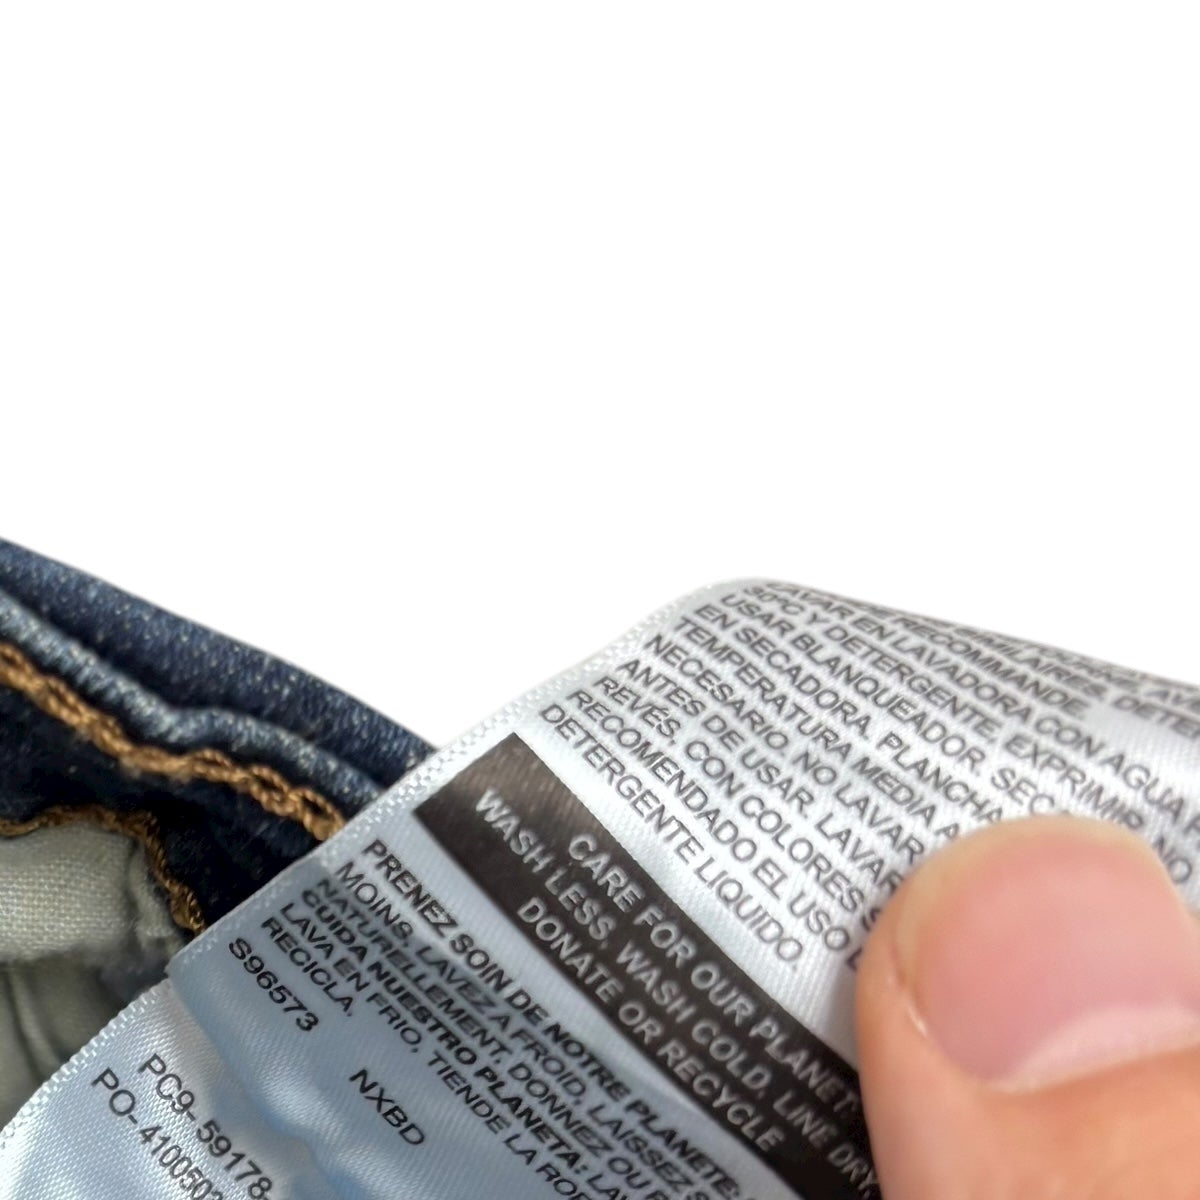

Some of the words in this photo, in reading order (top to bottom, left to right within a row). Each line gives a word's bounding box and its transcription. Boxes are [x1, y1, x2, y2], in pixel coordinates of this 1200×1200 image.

[616, 657, 707, 720] ANTES
[702, 713, 745, 752] DE
[741, 746, 816, 819] USAR.
[644, 634, 789, 756] NECESARIO.
[792, 750, 838, 787] NO
[835, 782, 925, 865] LAVAR
[674, 616, 853, 763] TEMPERATURA
[851, 756, 936, 827] MEDIA
[695, 604, 739, 630] EN
[734, 627, 872, 740] SECADORA.
[720, 594, 796, 637] USAR
[791, 633, 986, 776] BLANQUEADOR.
[991, 767, 1068, 815] SEC
[851, 616, 896, 640] EN
[891, 636, 1032, 724] LAVADORA
[1034, 716, 1105, 757] CON
[539, 704, 705, 865] DETERGENTE
[567, 688, 757, 863] RECOMENDADO
[751, 856, 789, 901] EL
[787, 891, 850, 951] USO
[685, 738, 745, 797] CON
[739, 795, 865, 913] COLORES
[279, 902, 335, 959] LAVA
[332, 959, 370, 993] EN
[365, 993, 423, 1053] FRIO,
[426, 1049, 512, 1135] TIENDE
[503, 1133, 538, 1165] LA
[302, 889, 368, 961] CUIDA
[367, 961, 478, 1066] NUESTRO
[474, 1066, 588, 1175] PLANETA:
[335, 860, 414, 948] MOINS,
[415, 945, 497, 1014] LAVEZ
[485, 1011, 511, 1032] A
[509, 1026, 587, 1105] FROID,
[587, 1103, 694, 1193] LAISSEZ
[362, 839, 460, 938] PRENEZ
[450, 933, 513, 994] SOIN
[507, 989, 550, 1027] DE
[543, 1022, 632, 1102] NOTRE
[474, 790, 548, 873] WASH
[615, 940, 697, 1024] WASH
[773, 1090, 838, 1147] LINE
[516, 897, 625, 1003] DONATE
[618, 1002, 664, 1045] OR
[657, 1040, 786, 1151] RECYCLE
[567, 833, 646, 913] CARE
[633, 905, 696, 968] FOR
[690, 962, 755, 1027] OUR
[228, 937, 319, 1032] S96573
[349, 1068, 425, 1145] NXBD
[507, 1062, 613, 1156] DONNEZ
[607, 1156, 652, 1190] OU
